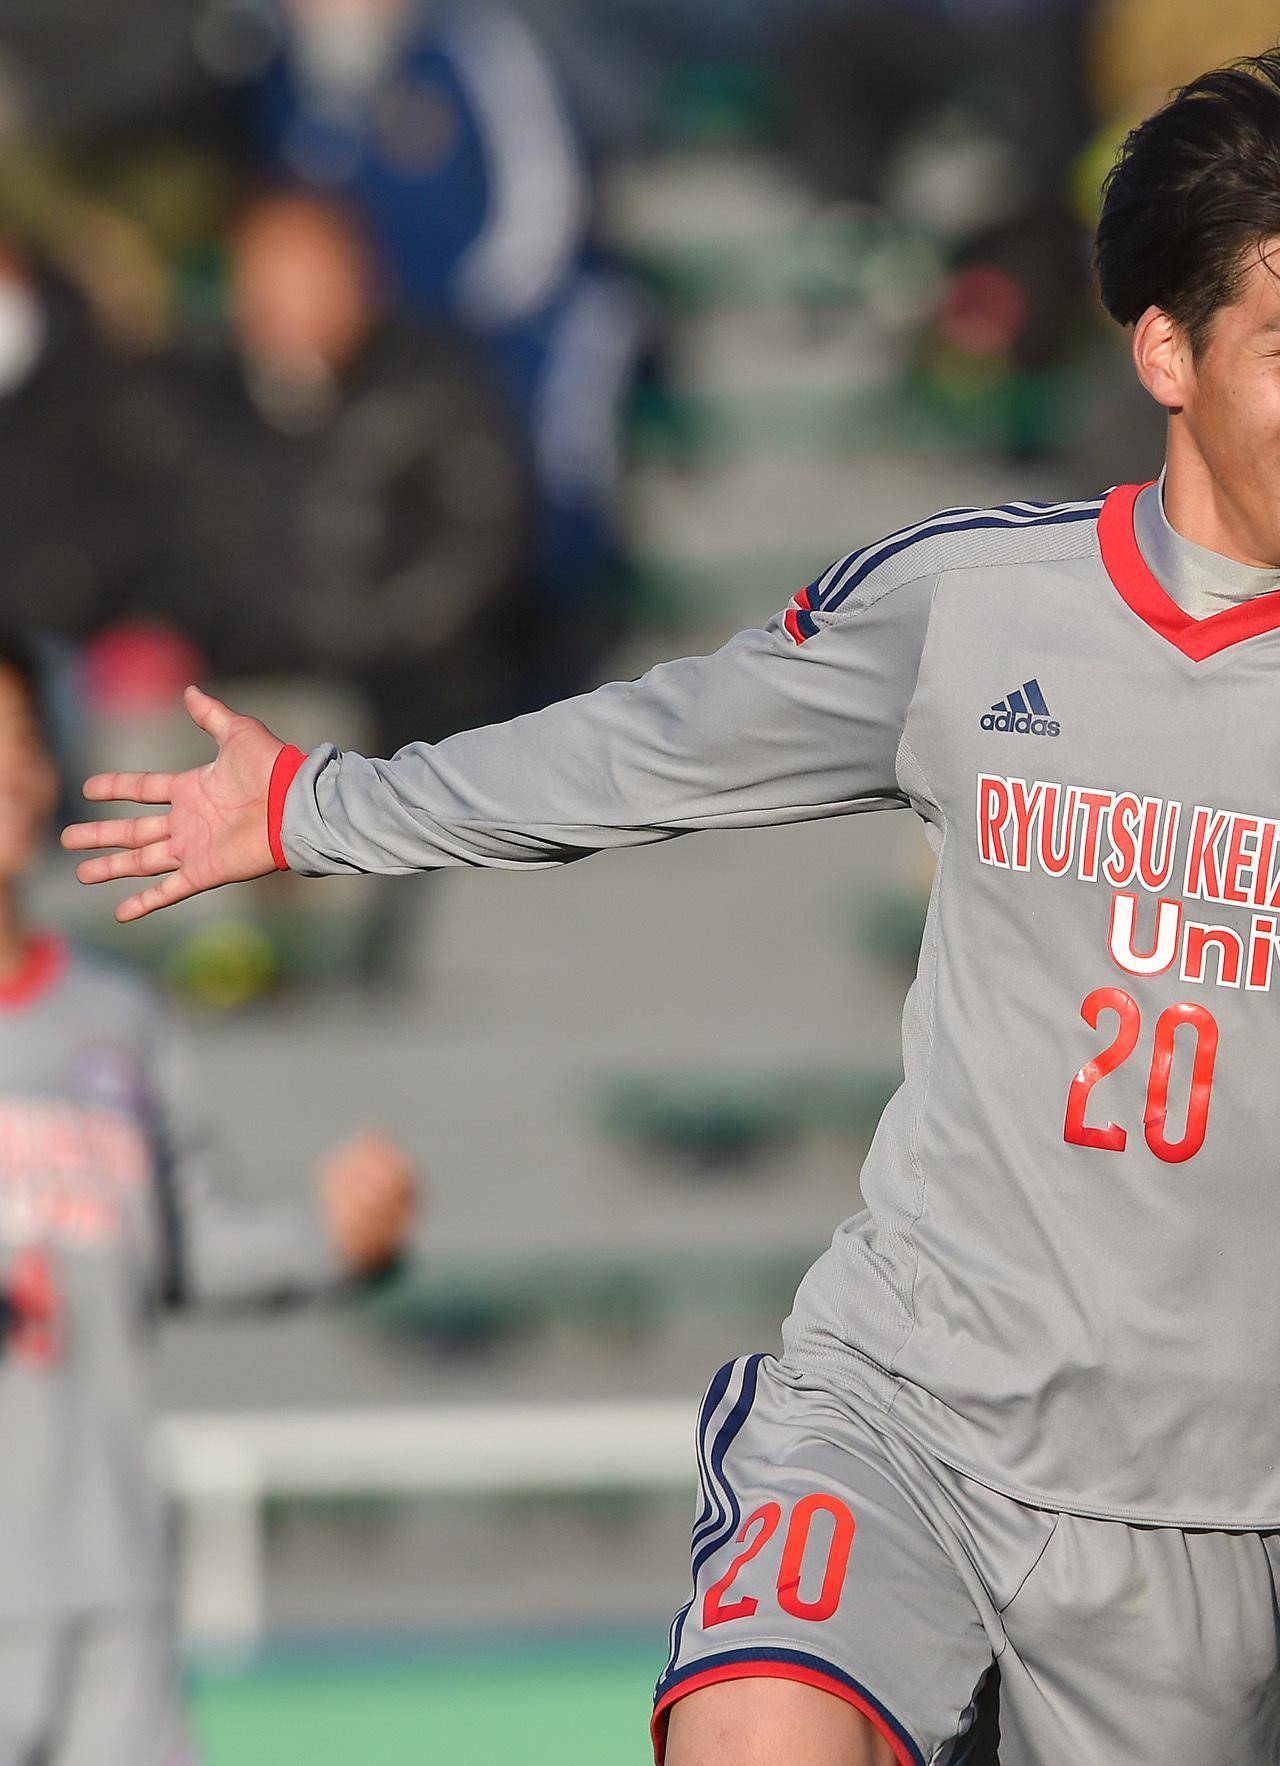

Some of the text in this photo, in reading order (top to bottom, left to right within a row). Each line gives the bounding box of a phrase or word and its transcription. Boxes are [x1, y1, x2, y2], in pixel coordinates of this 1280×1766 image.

[980, 711, 1061, 737] adidas
[977, 773, 1182, 893] RYUTSU
[1063, 986, 1219, 1164] 20
[702, 1492, 856, 1631] 20
